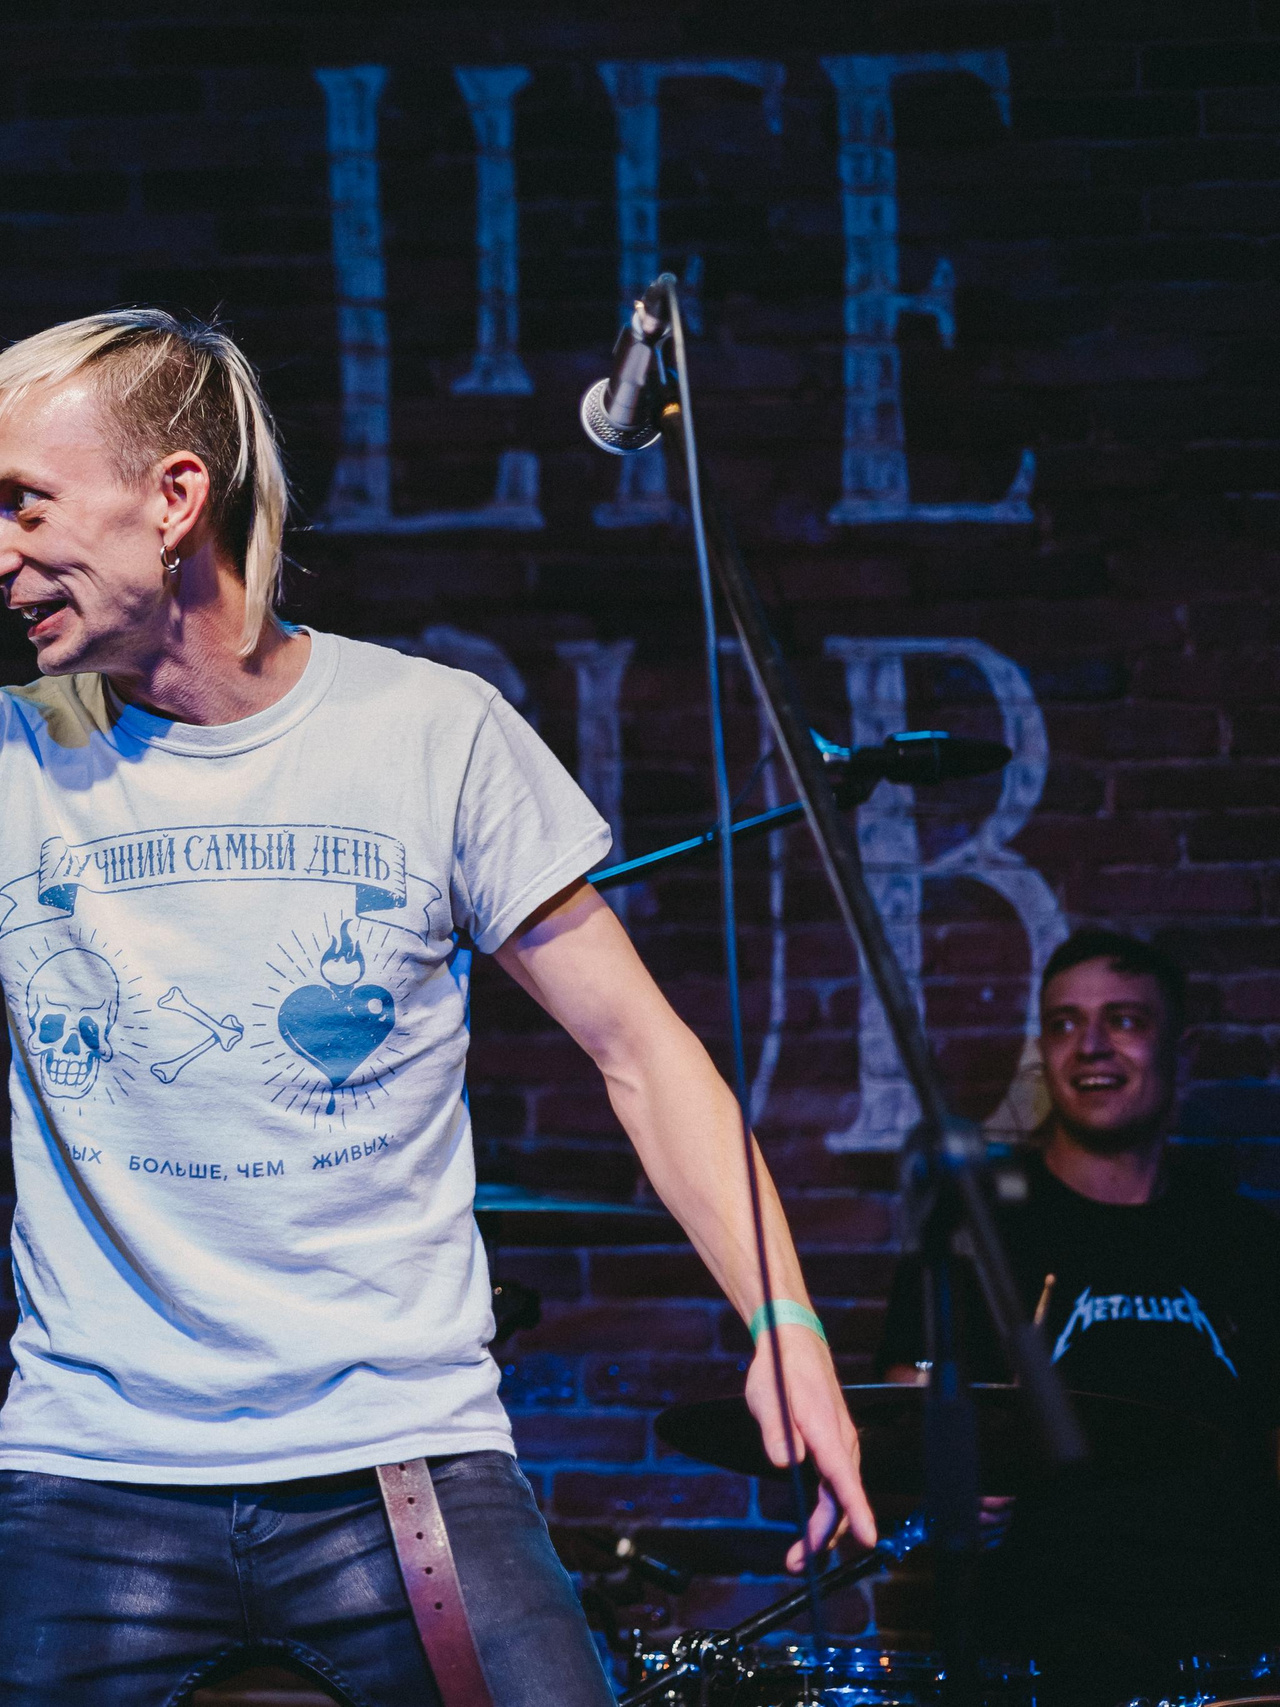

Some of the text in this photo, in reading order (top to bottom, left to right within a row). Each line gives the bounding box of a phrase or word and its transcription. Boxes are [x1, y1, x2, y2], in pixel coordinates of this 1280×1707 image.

[183, 829, 296, 872] САМЫЙ
[303, 834, 391, 881] ДЕНЬ
[360, 624, 1070, 1156] UB
[128, 1154, 228, 1182] БОЛЬШЕ,
[236, 1159, 285, 1179] ЧЕМ
